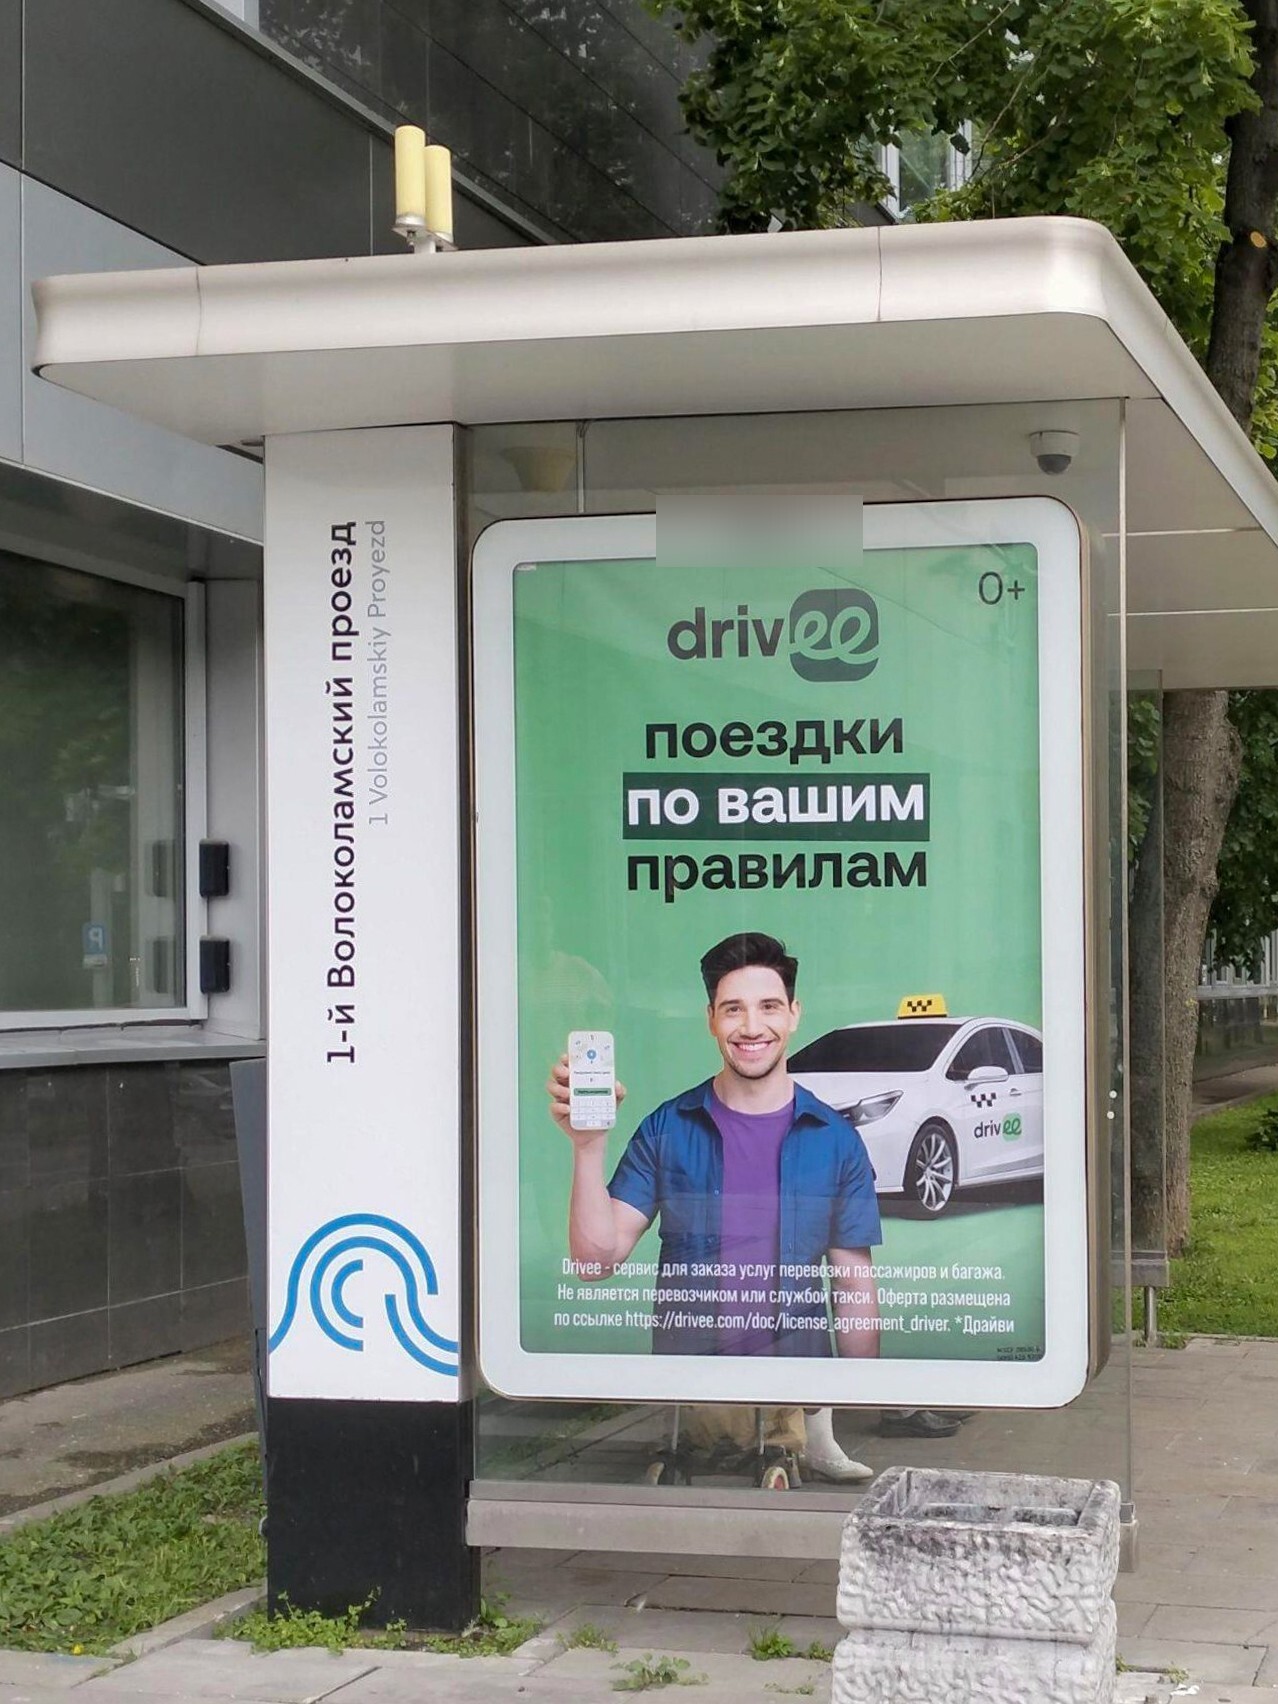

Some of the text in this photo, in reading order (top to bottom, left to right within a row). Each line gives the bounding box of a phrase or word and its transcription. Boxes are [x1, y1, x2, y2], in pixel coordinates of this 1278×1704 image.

[978, 571, 1026, 605] 0+
[667, 602, 880, 668] drivee
[365, 520, 391, 825] 1 Volokolamskiy Proyezd
[646, 717, 904, 765] поездки
[325, 521, 359, 1063] 1-й Волоколамский проезд
[627, 783, 925, 826] по вашим
[627, 850, 927, 903] правилам
[974, 1116, 1023, 1140] drivee
[562, 1258, 602, 1275] Drivee
[613, 1263, 659, 1278] сервис
[661, 1263, 688, 1278] для
[691, 1263, 736, 1278] заказа
[740, 1264, 775, 1280] услуг
[779, 1264, 850, 1280] перевозки
[854, 1265, 937, 1281] пассажиров
[940, 1266, 949, 1279] и
[952, 1262, 1005, 1280] багажа.
[557, 1284, 1011, 1308] Не является перевозчиком или службой такси. Оферта размещена
[554, 1312, 570, 1326] по
[573, 1312, 623, 1326] ссылке
